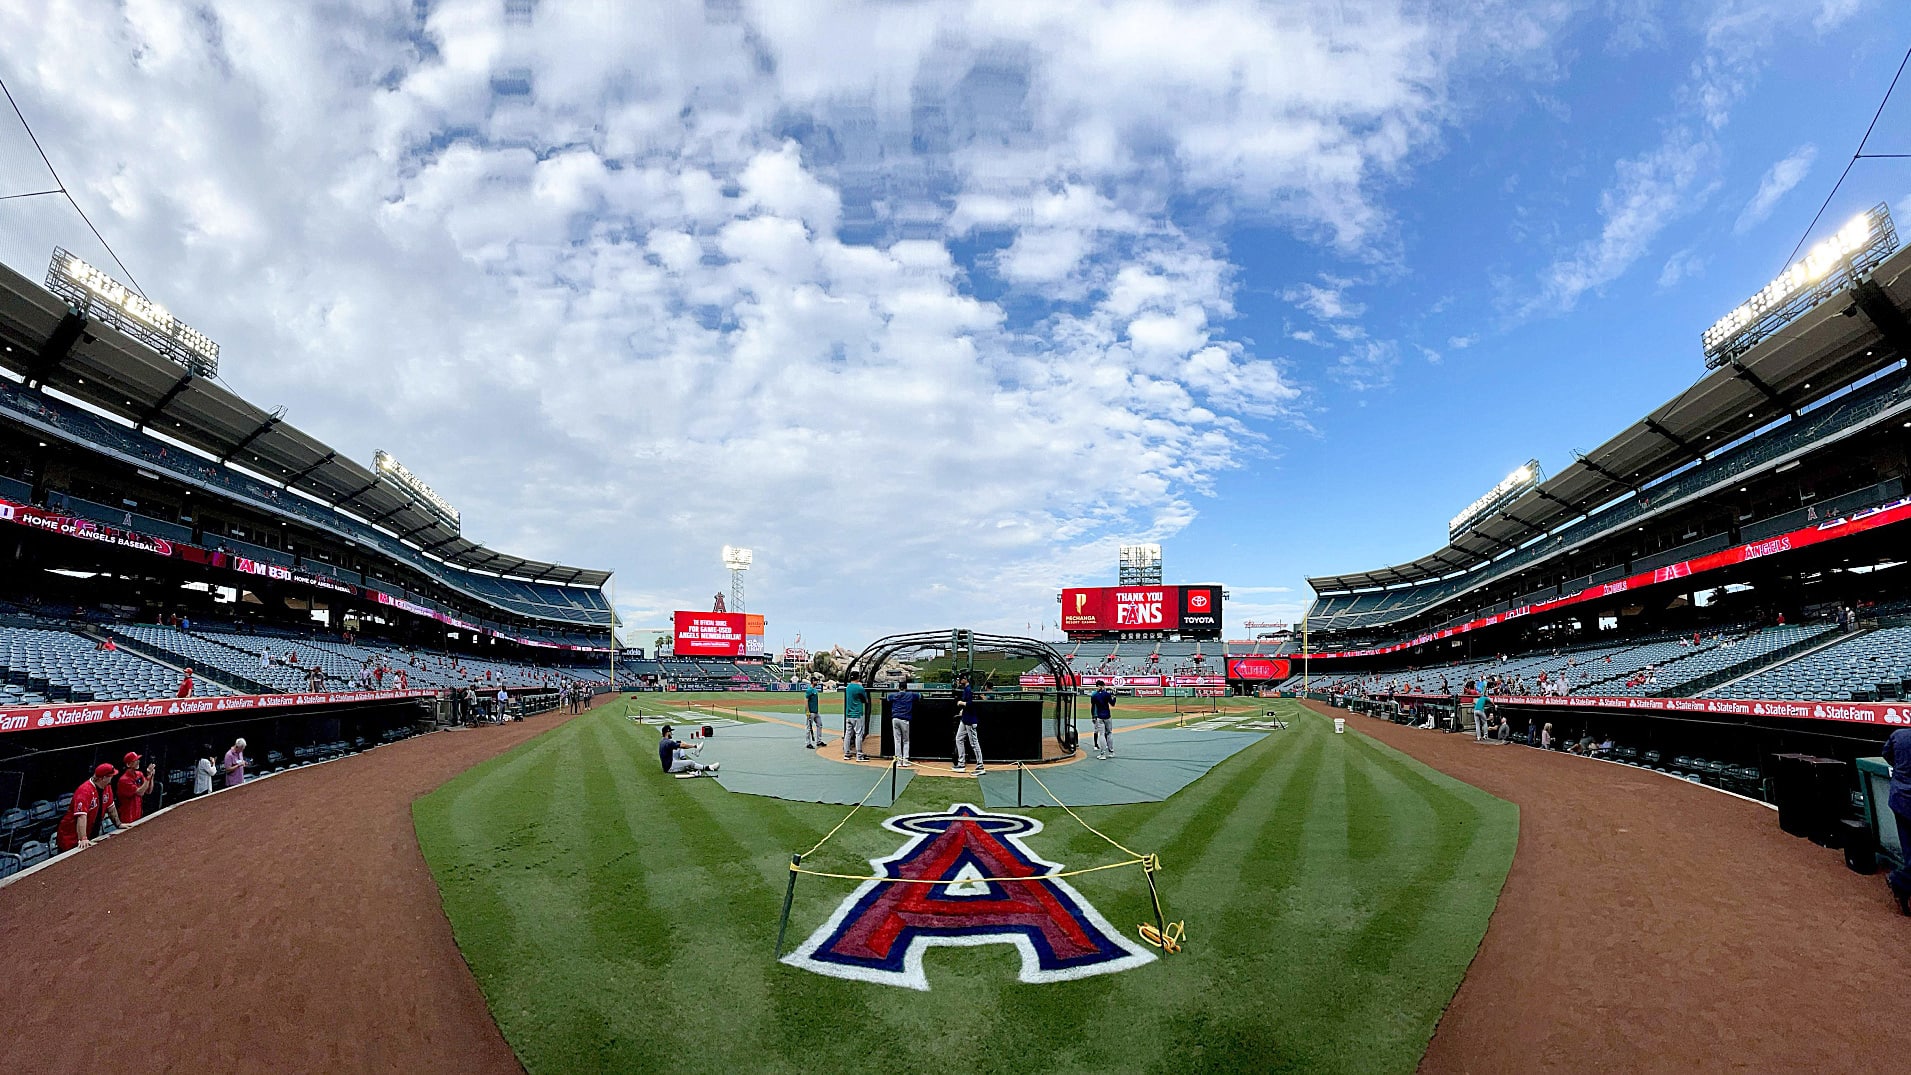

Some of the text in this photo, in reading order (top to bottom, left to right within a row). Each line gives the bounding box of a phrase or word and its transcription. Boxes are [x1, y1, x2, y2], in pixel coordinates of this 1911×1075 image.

[22, 514, 158, 552] HOME OF ANGELS BASEBALL
[1745, 537, 1791, 560] ANGELS
[238, 558, 266, 576] AM
[268, 565, 291, 581] 830
[294, 575, 309, 584] HOME
[1116, 592, 1163, 602] THANK YOU
[1117, 602, 1163, 624] FANS
[1184, 616, 1215, 624] TOYOTA
[700, 626, 732, 634] GAME-USED
